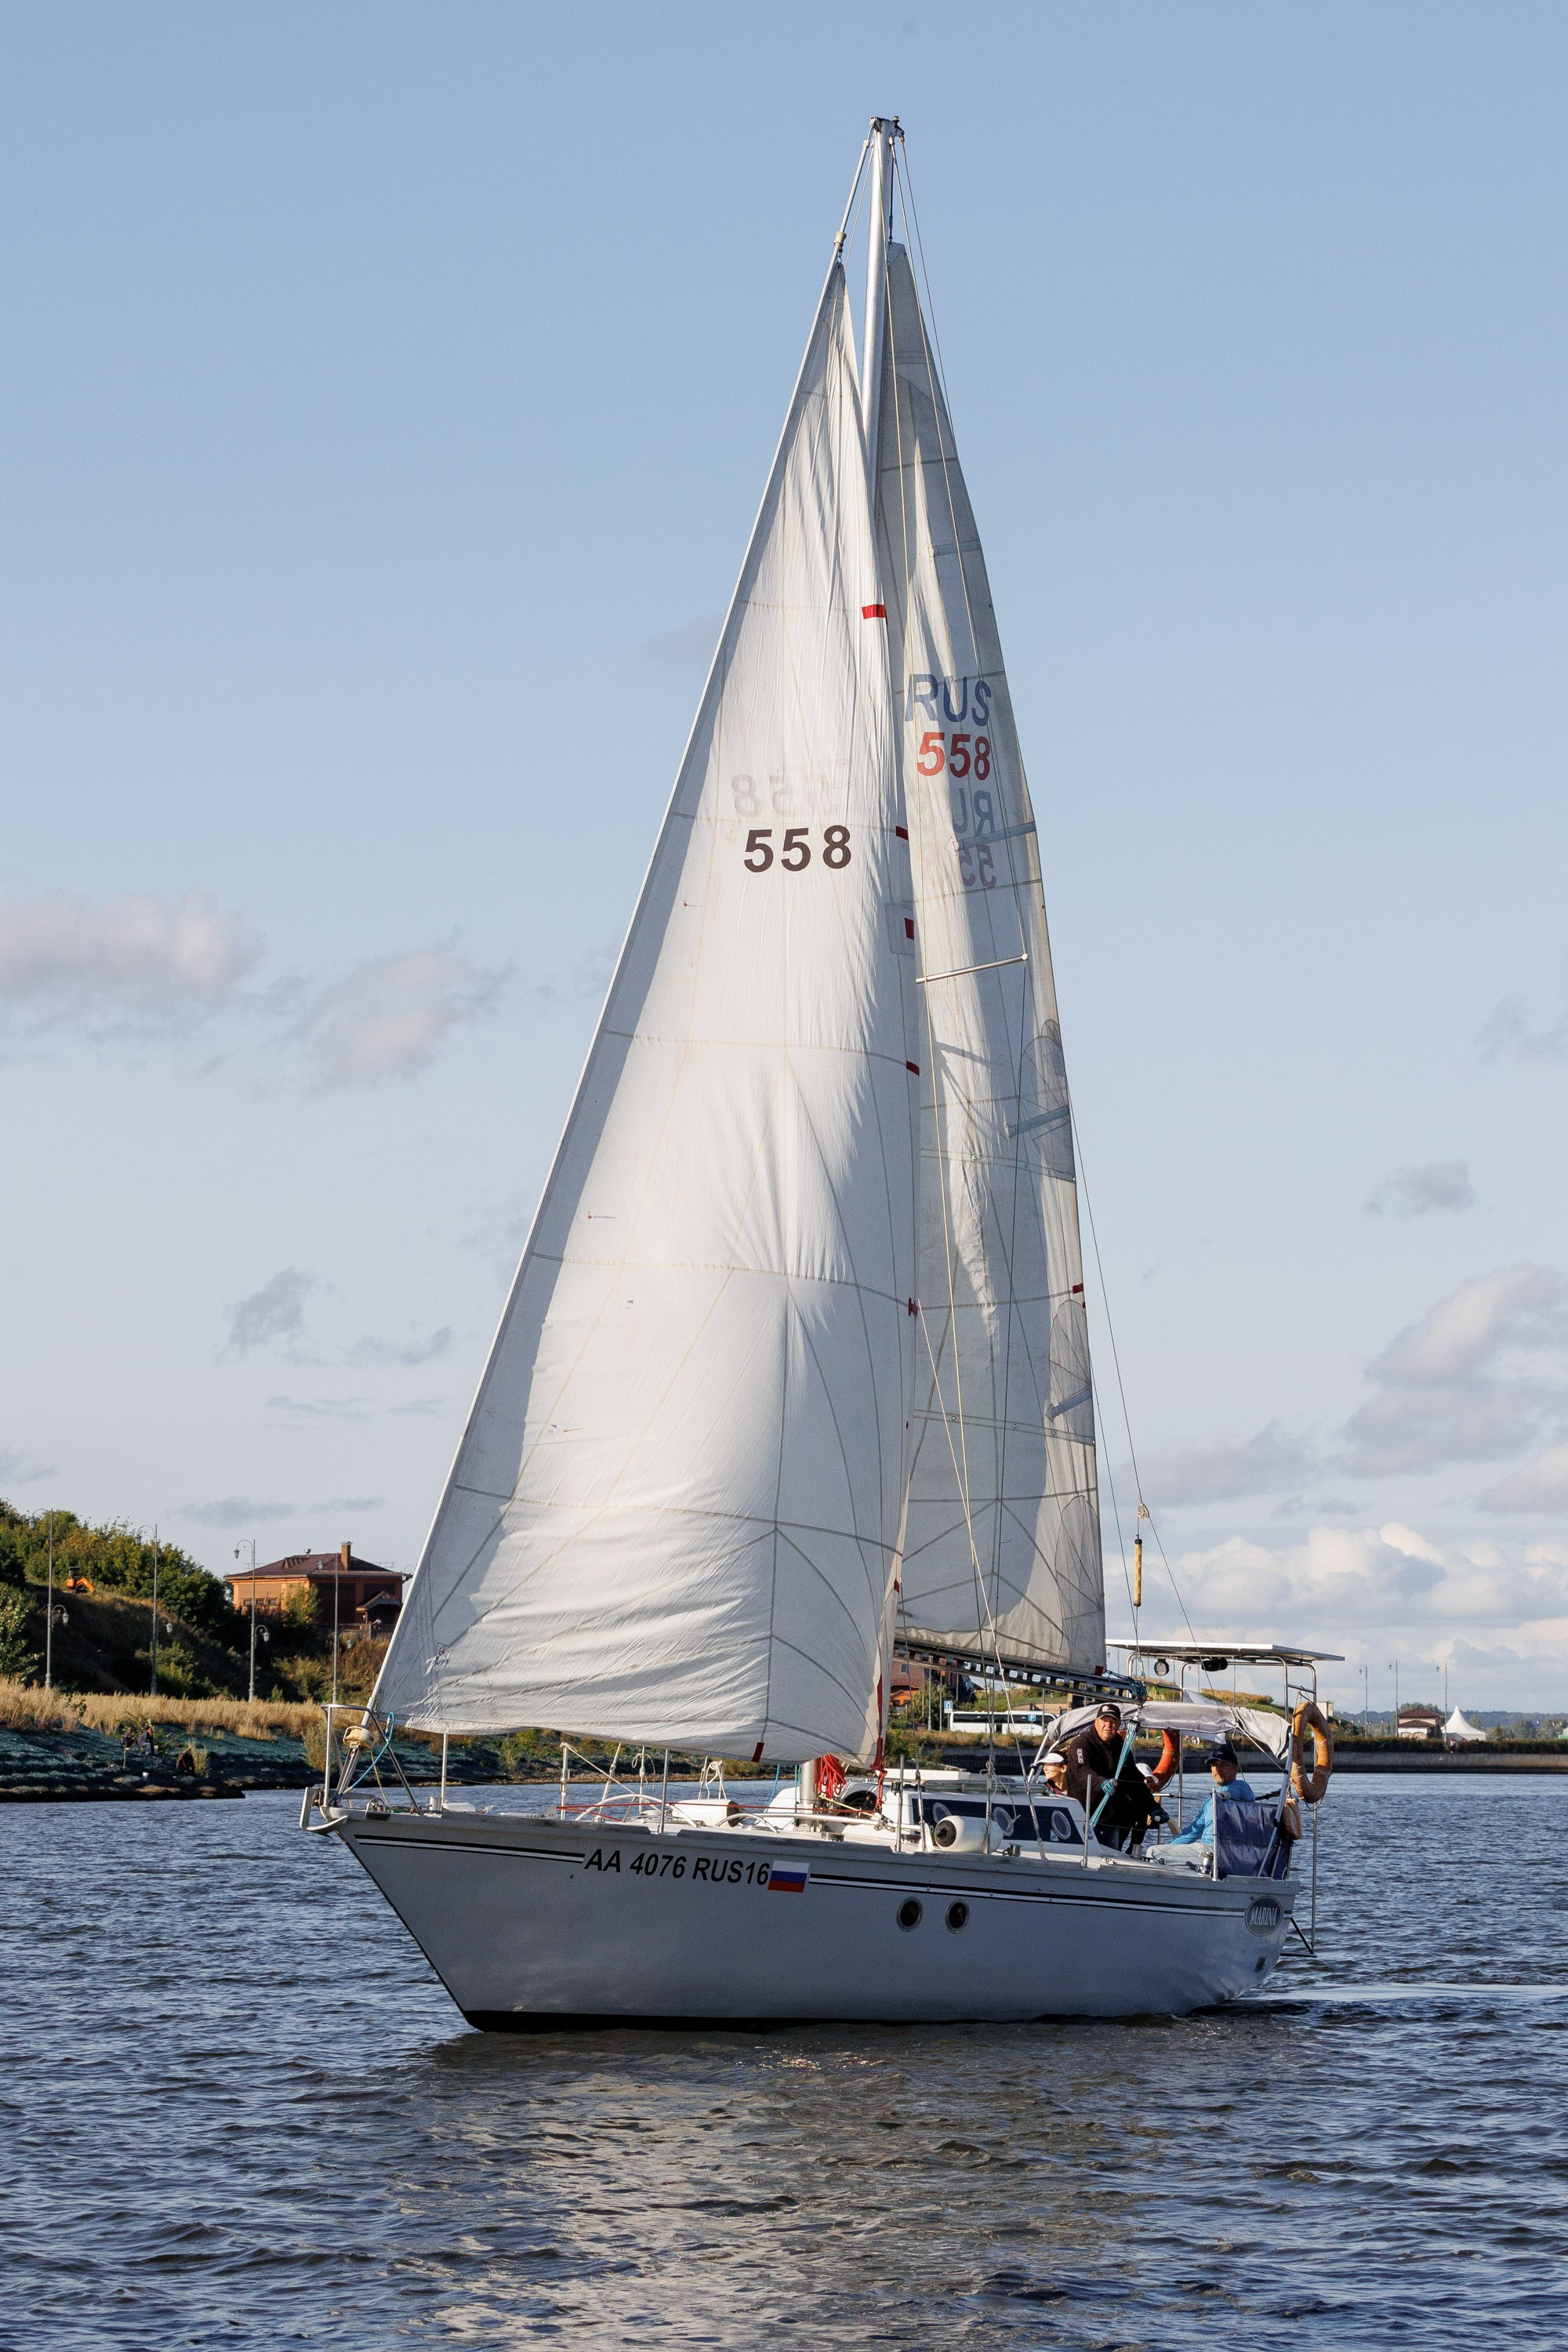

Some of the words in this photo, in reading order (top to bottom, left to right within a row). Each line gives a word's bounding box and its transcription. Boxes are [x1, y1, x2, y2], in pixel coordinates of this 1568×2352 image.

[904, 673, 993, 728] RUS
[916, 731, 991, 781] 558
[743, 825, 851, 873] 558
[584, 1849, 621, 1873] AA
[630, 1853, 686, 1878] 4076
[691, 1857, 771, 1886] RUS16
[1250, 1907, 1278, 1926] MARINA
